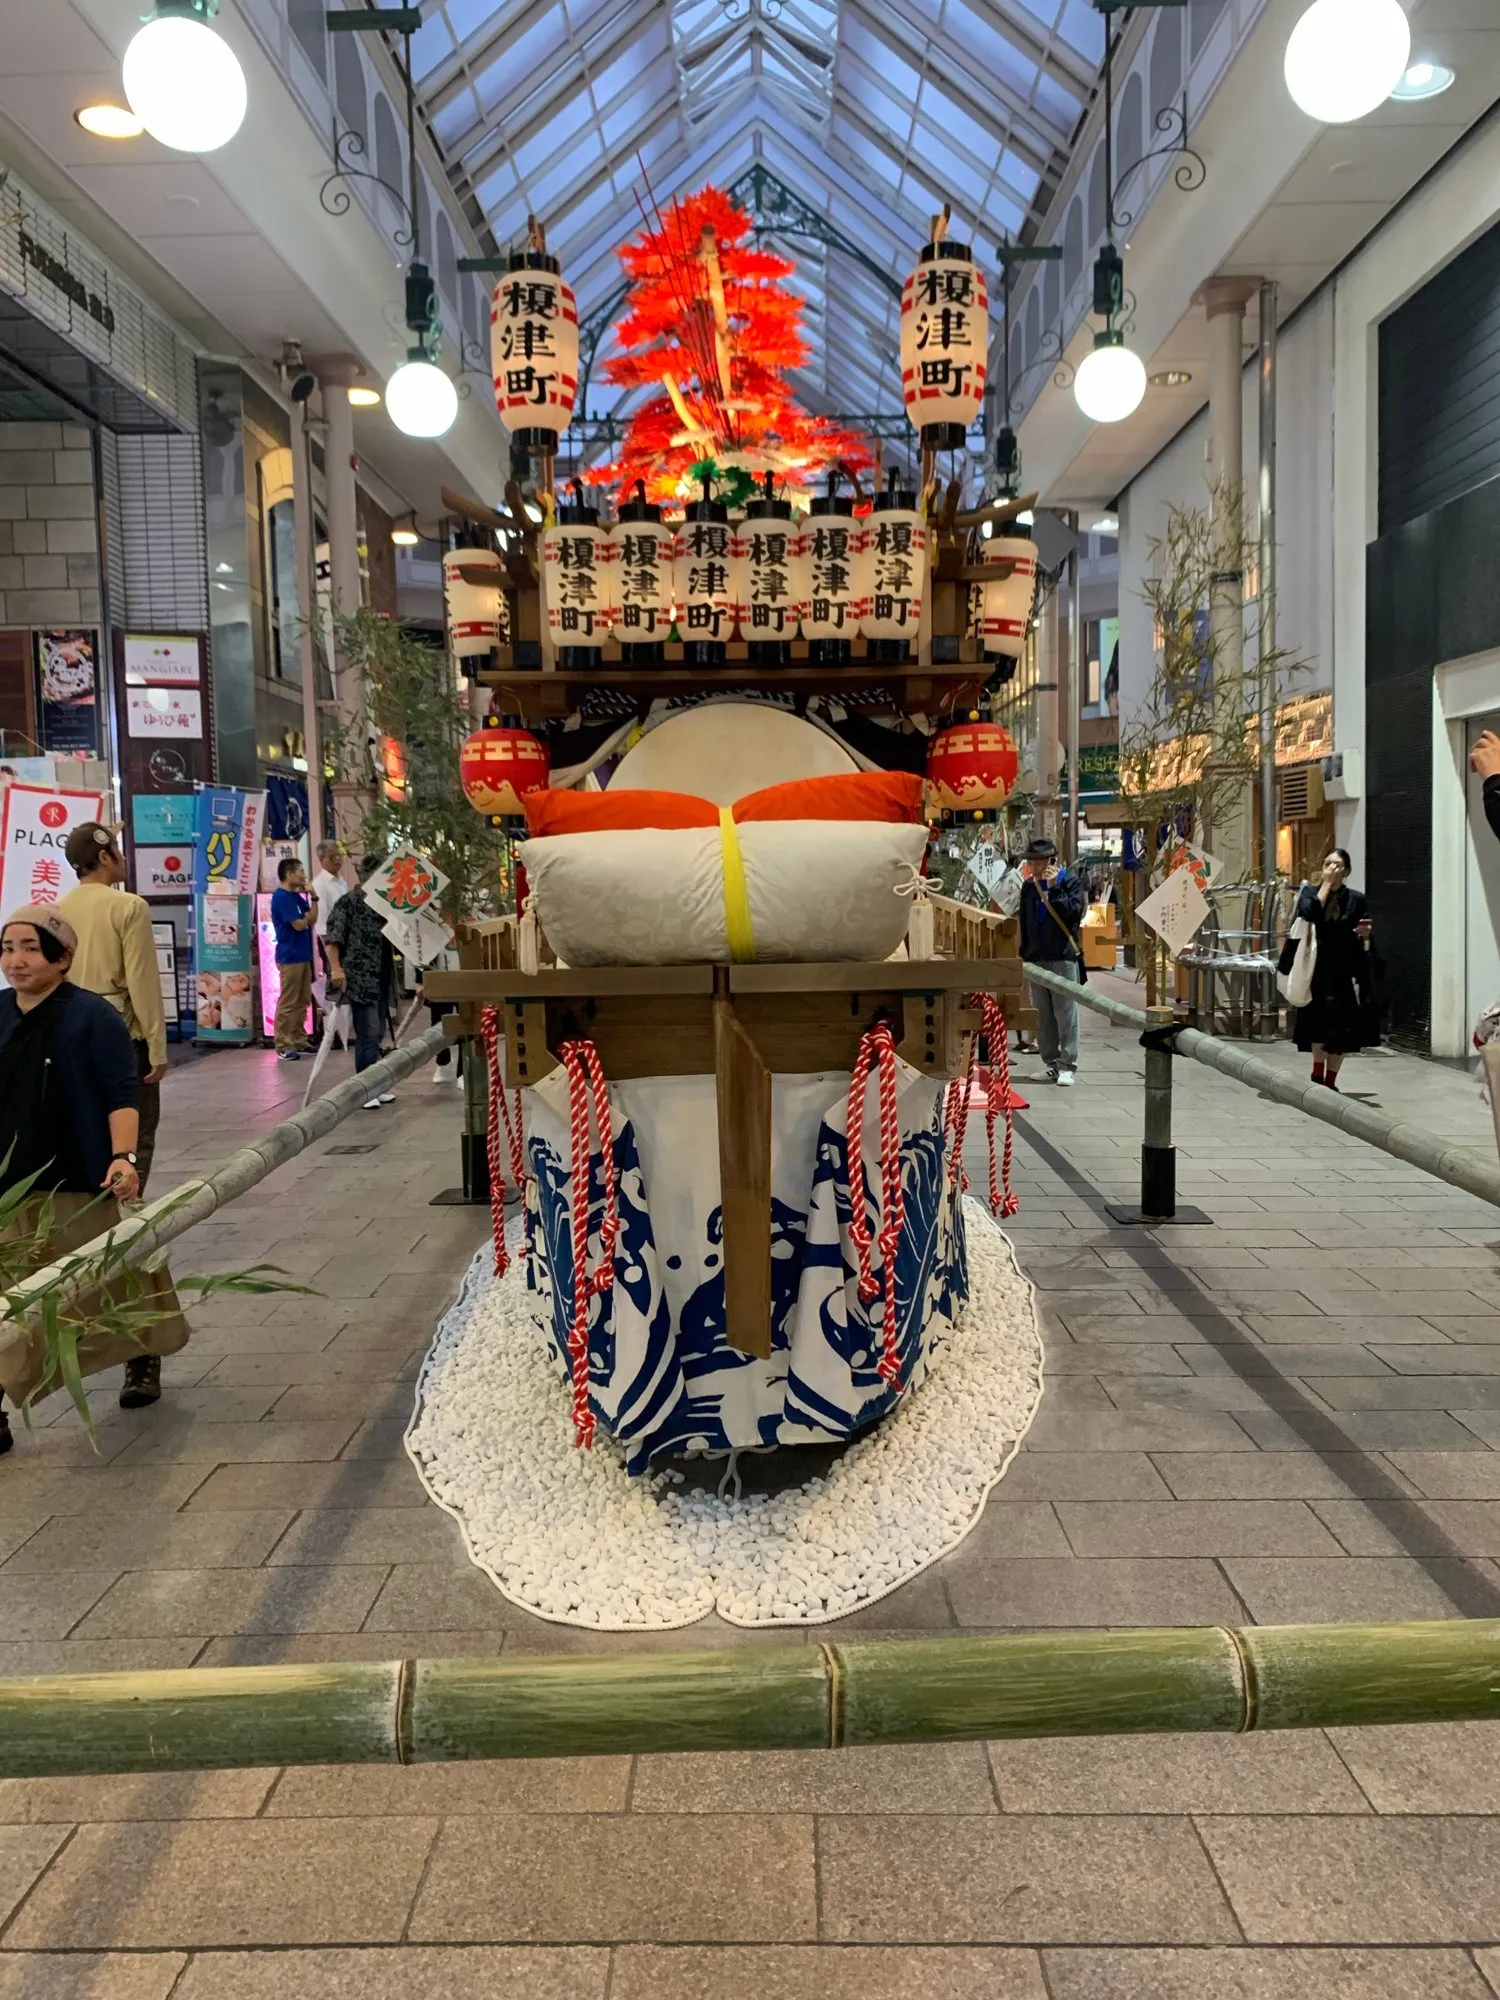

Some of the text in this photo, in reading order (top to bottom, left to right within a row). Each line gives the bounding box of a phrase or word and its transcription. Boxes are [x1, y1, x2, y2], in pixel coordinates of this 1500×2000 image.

[501, 281, 559, 405] 榎津町
[915, 269, 974, 397] 榎津町
[557, 536, 597, 637] 榎津町
[620, 534, 660, 634] 榎津町
[687, 524, 730, 638] 榎津町
[749, 532, 789, 633] 榎津町
[810, 527, 850, 630] 榎津町
[874, 521, 914, 627] 榎津町
[14, 828, 69, 849] PLAG
[206, 832, 236, 882] パソ
